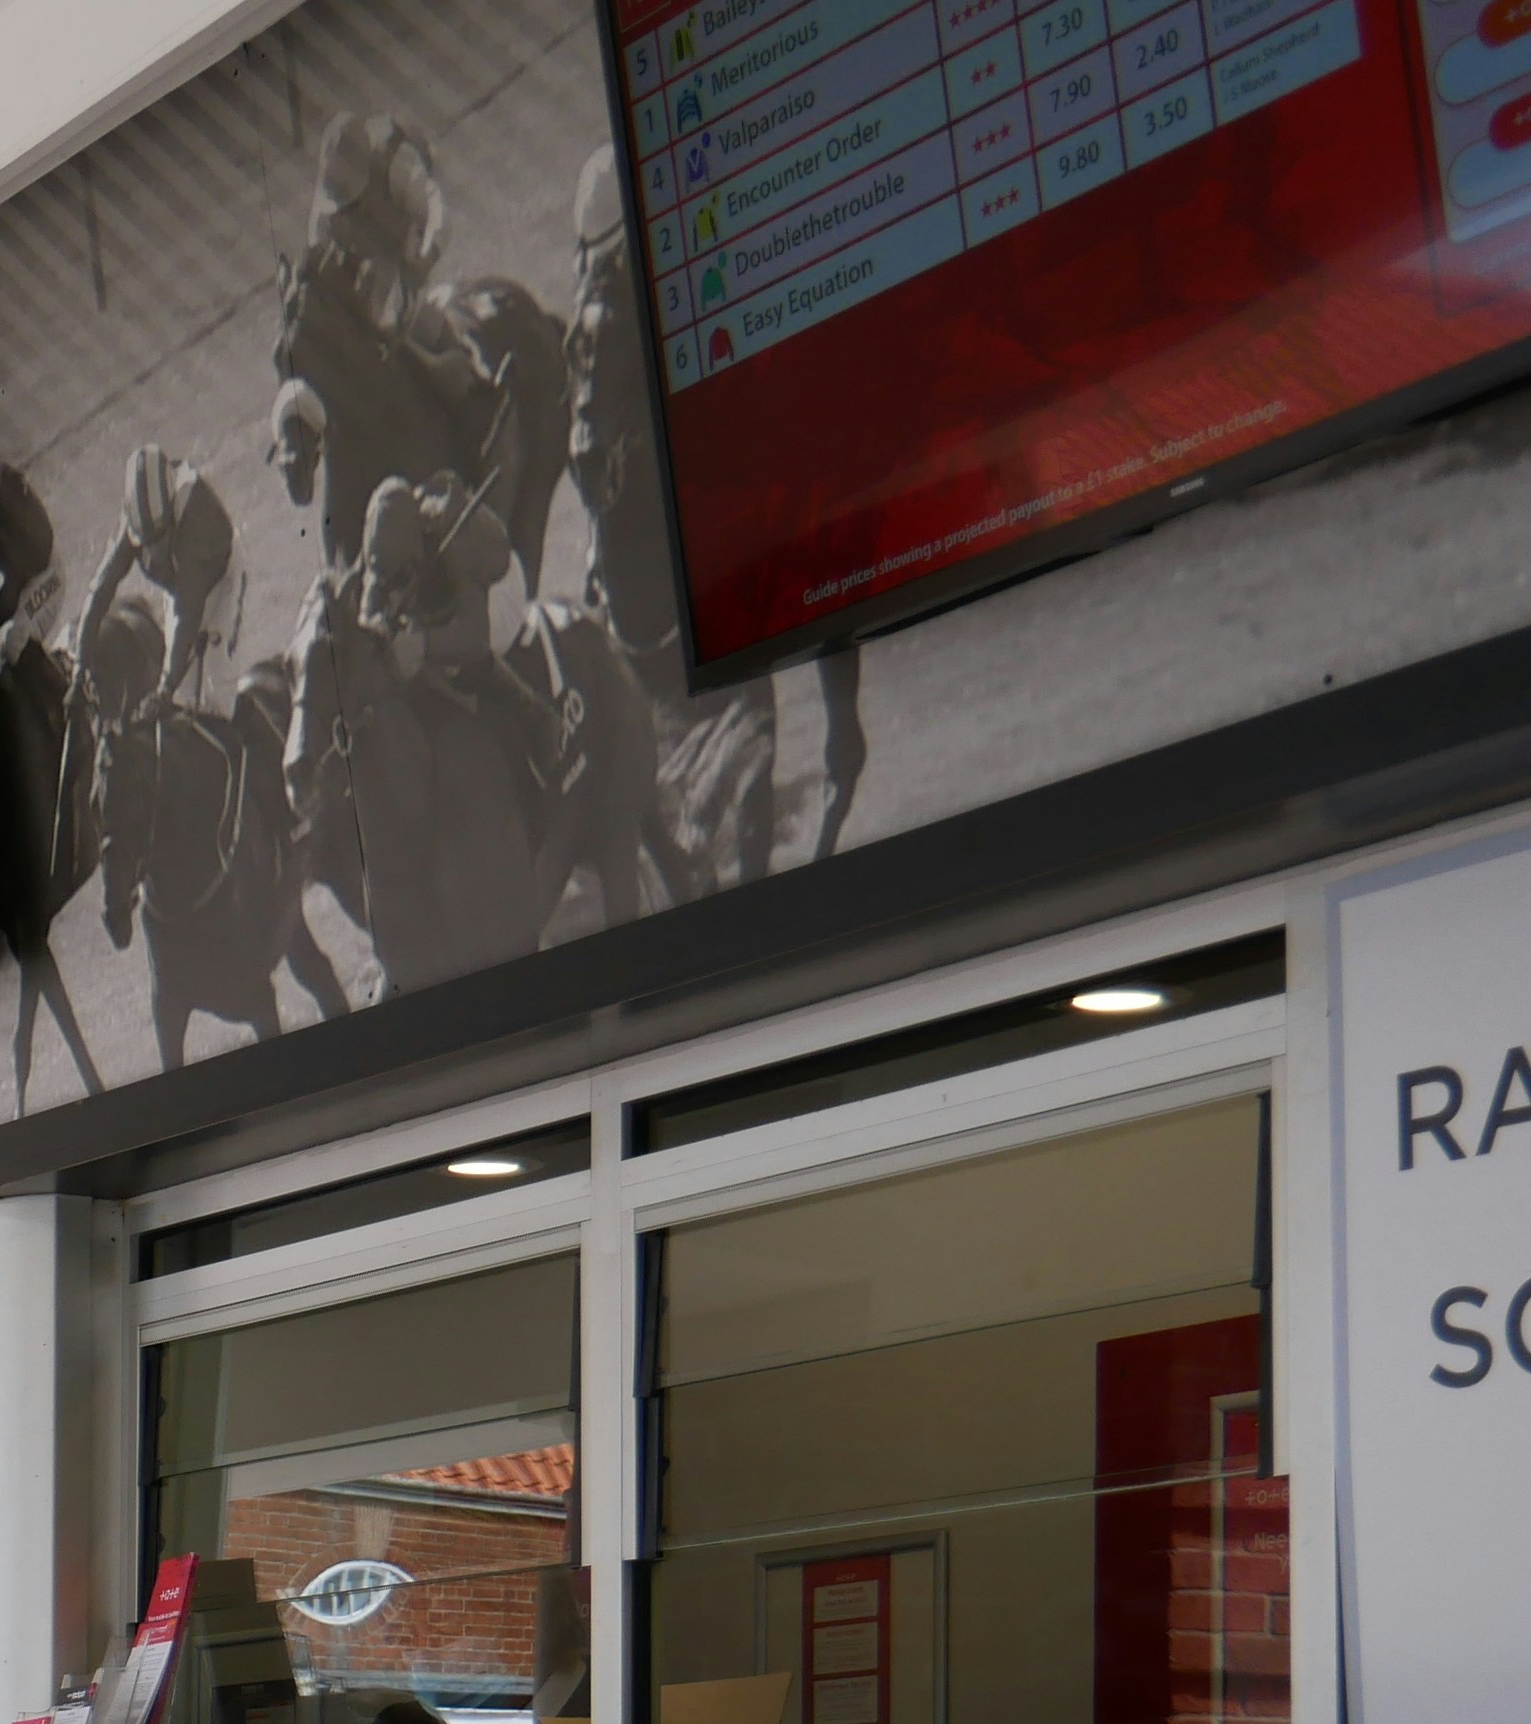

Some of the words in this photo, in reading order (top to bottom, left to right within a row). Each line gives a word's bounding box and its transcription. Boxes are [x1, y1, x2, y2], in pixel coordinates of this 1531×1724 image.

[702, 0, 767, 36] Bailey
[1040, 6, 1083, 47] 7.30
[636, 50, 648, 76] 5
[711, 19, 819, 96] Meritorious
[1135, 28, 1179, 70] 2.40
[1049, 73, 1092, 112] 7.90
[644, 107, 654, 133] 1
[718, 88, 816, 155] Valparaiso
[1143, 96, 1188, 137] 3.50
[652, 166, 664, 191] 4
[725, 151, 823, 218] Encounter
[825, 116, 883, 164] Order
[1058, 140, 1100, 178] 9.80
[659, 226, 672, 254] 2
[734, 171, 906, 277] Doublethetrouble
[667, 285, 679, 311] 3
[742, 300, 785, 337] Easy
[788, 256, 874, 317] Equation
[675, 343, 688, 370] 6
[802, 578, 839, 606] Guide
[840, 561, 878, 595] prices
[879, 540, 933, 576] showing
[934, 539, 942, 553] a
[944, 508, 1007, 553] projected
[1009, 491, 1057, 528] payout
[1057, 485, 1073, 502] to
[1148, 430, 1207, 464] Subject
[1207, 423, 1224, 440] to
[1225, 399, 1288, 435] change.
